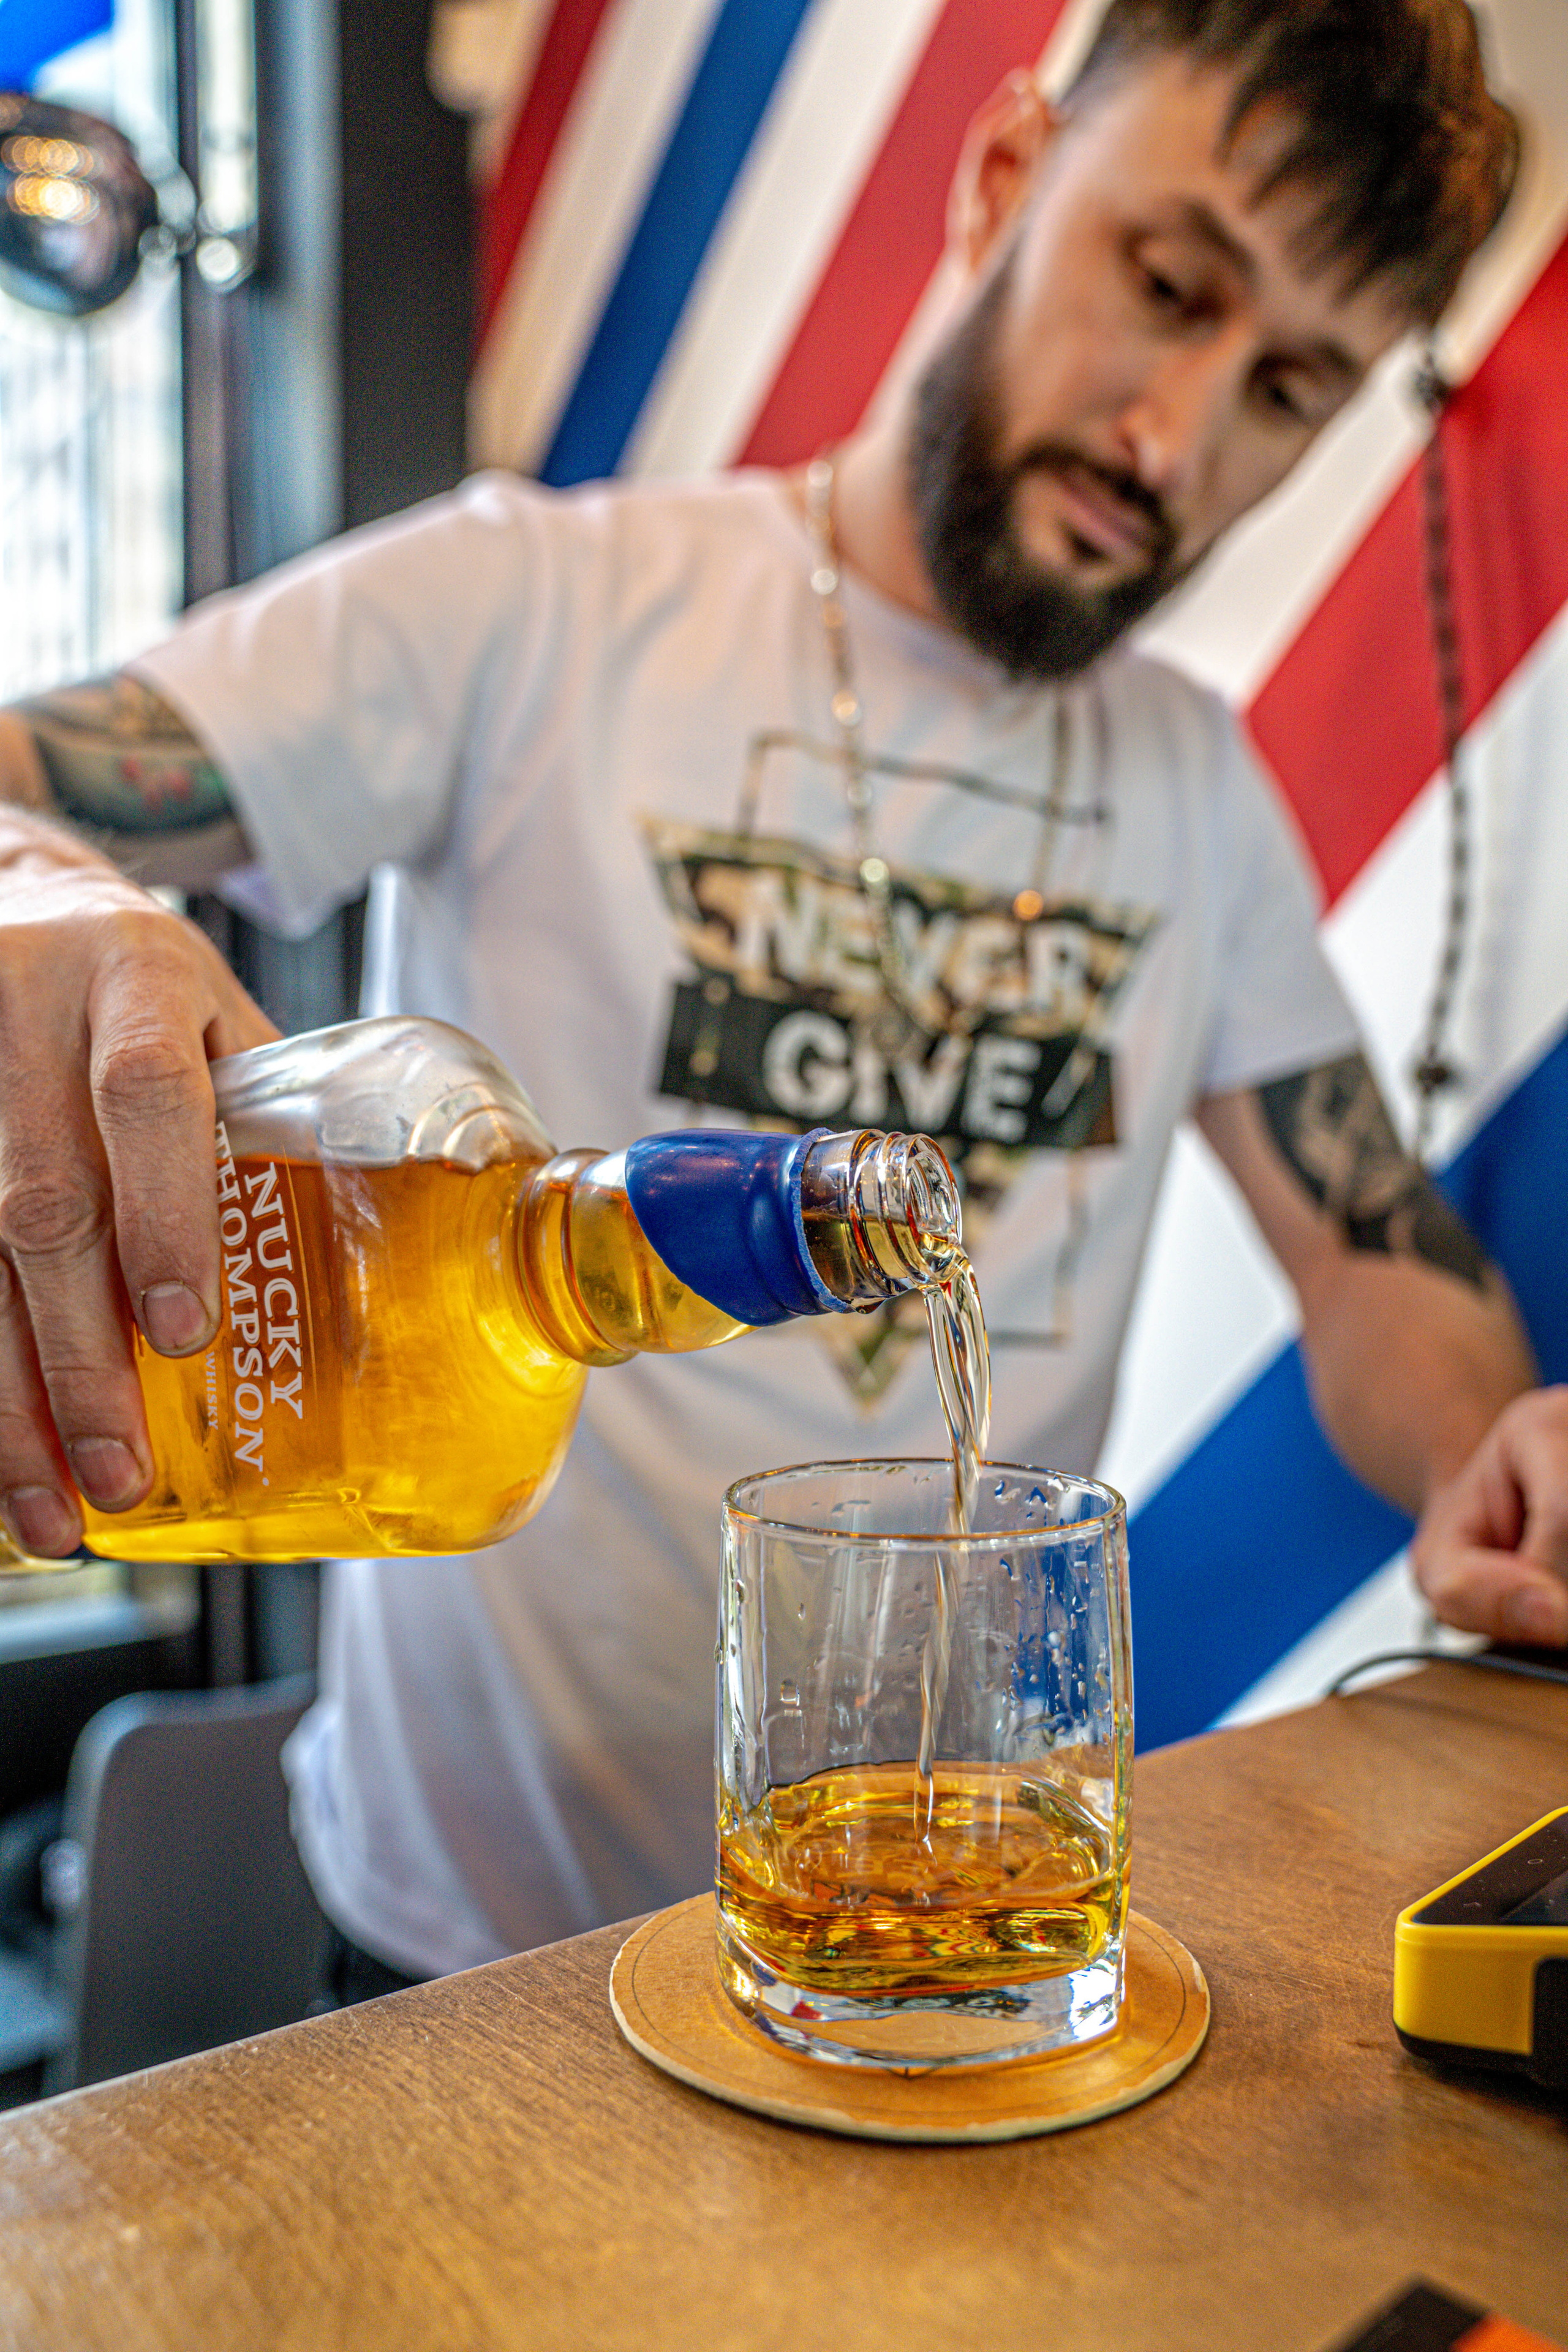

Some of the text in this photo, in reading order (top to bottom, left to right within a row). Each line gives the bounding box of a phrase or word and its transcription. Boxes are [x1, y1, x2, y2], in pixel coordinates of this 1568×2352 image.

[734, 862, 1095, 1028] NEVER
[763, 1009, 1042, 1144] GIVE
[216, 1120, 263, 1472] THOMPSON
[244, 1161, 303, 1420] NUCKY
[205, 1351, 218, 1430] WHISKY
